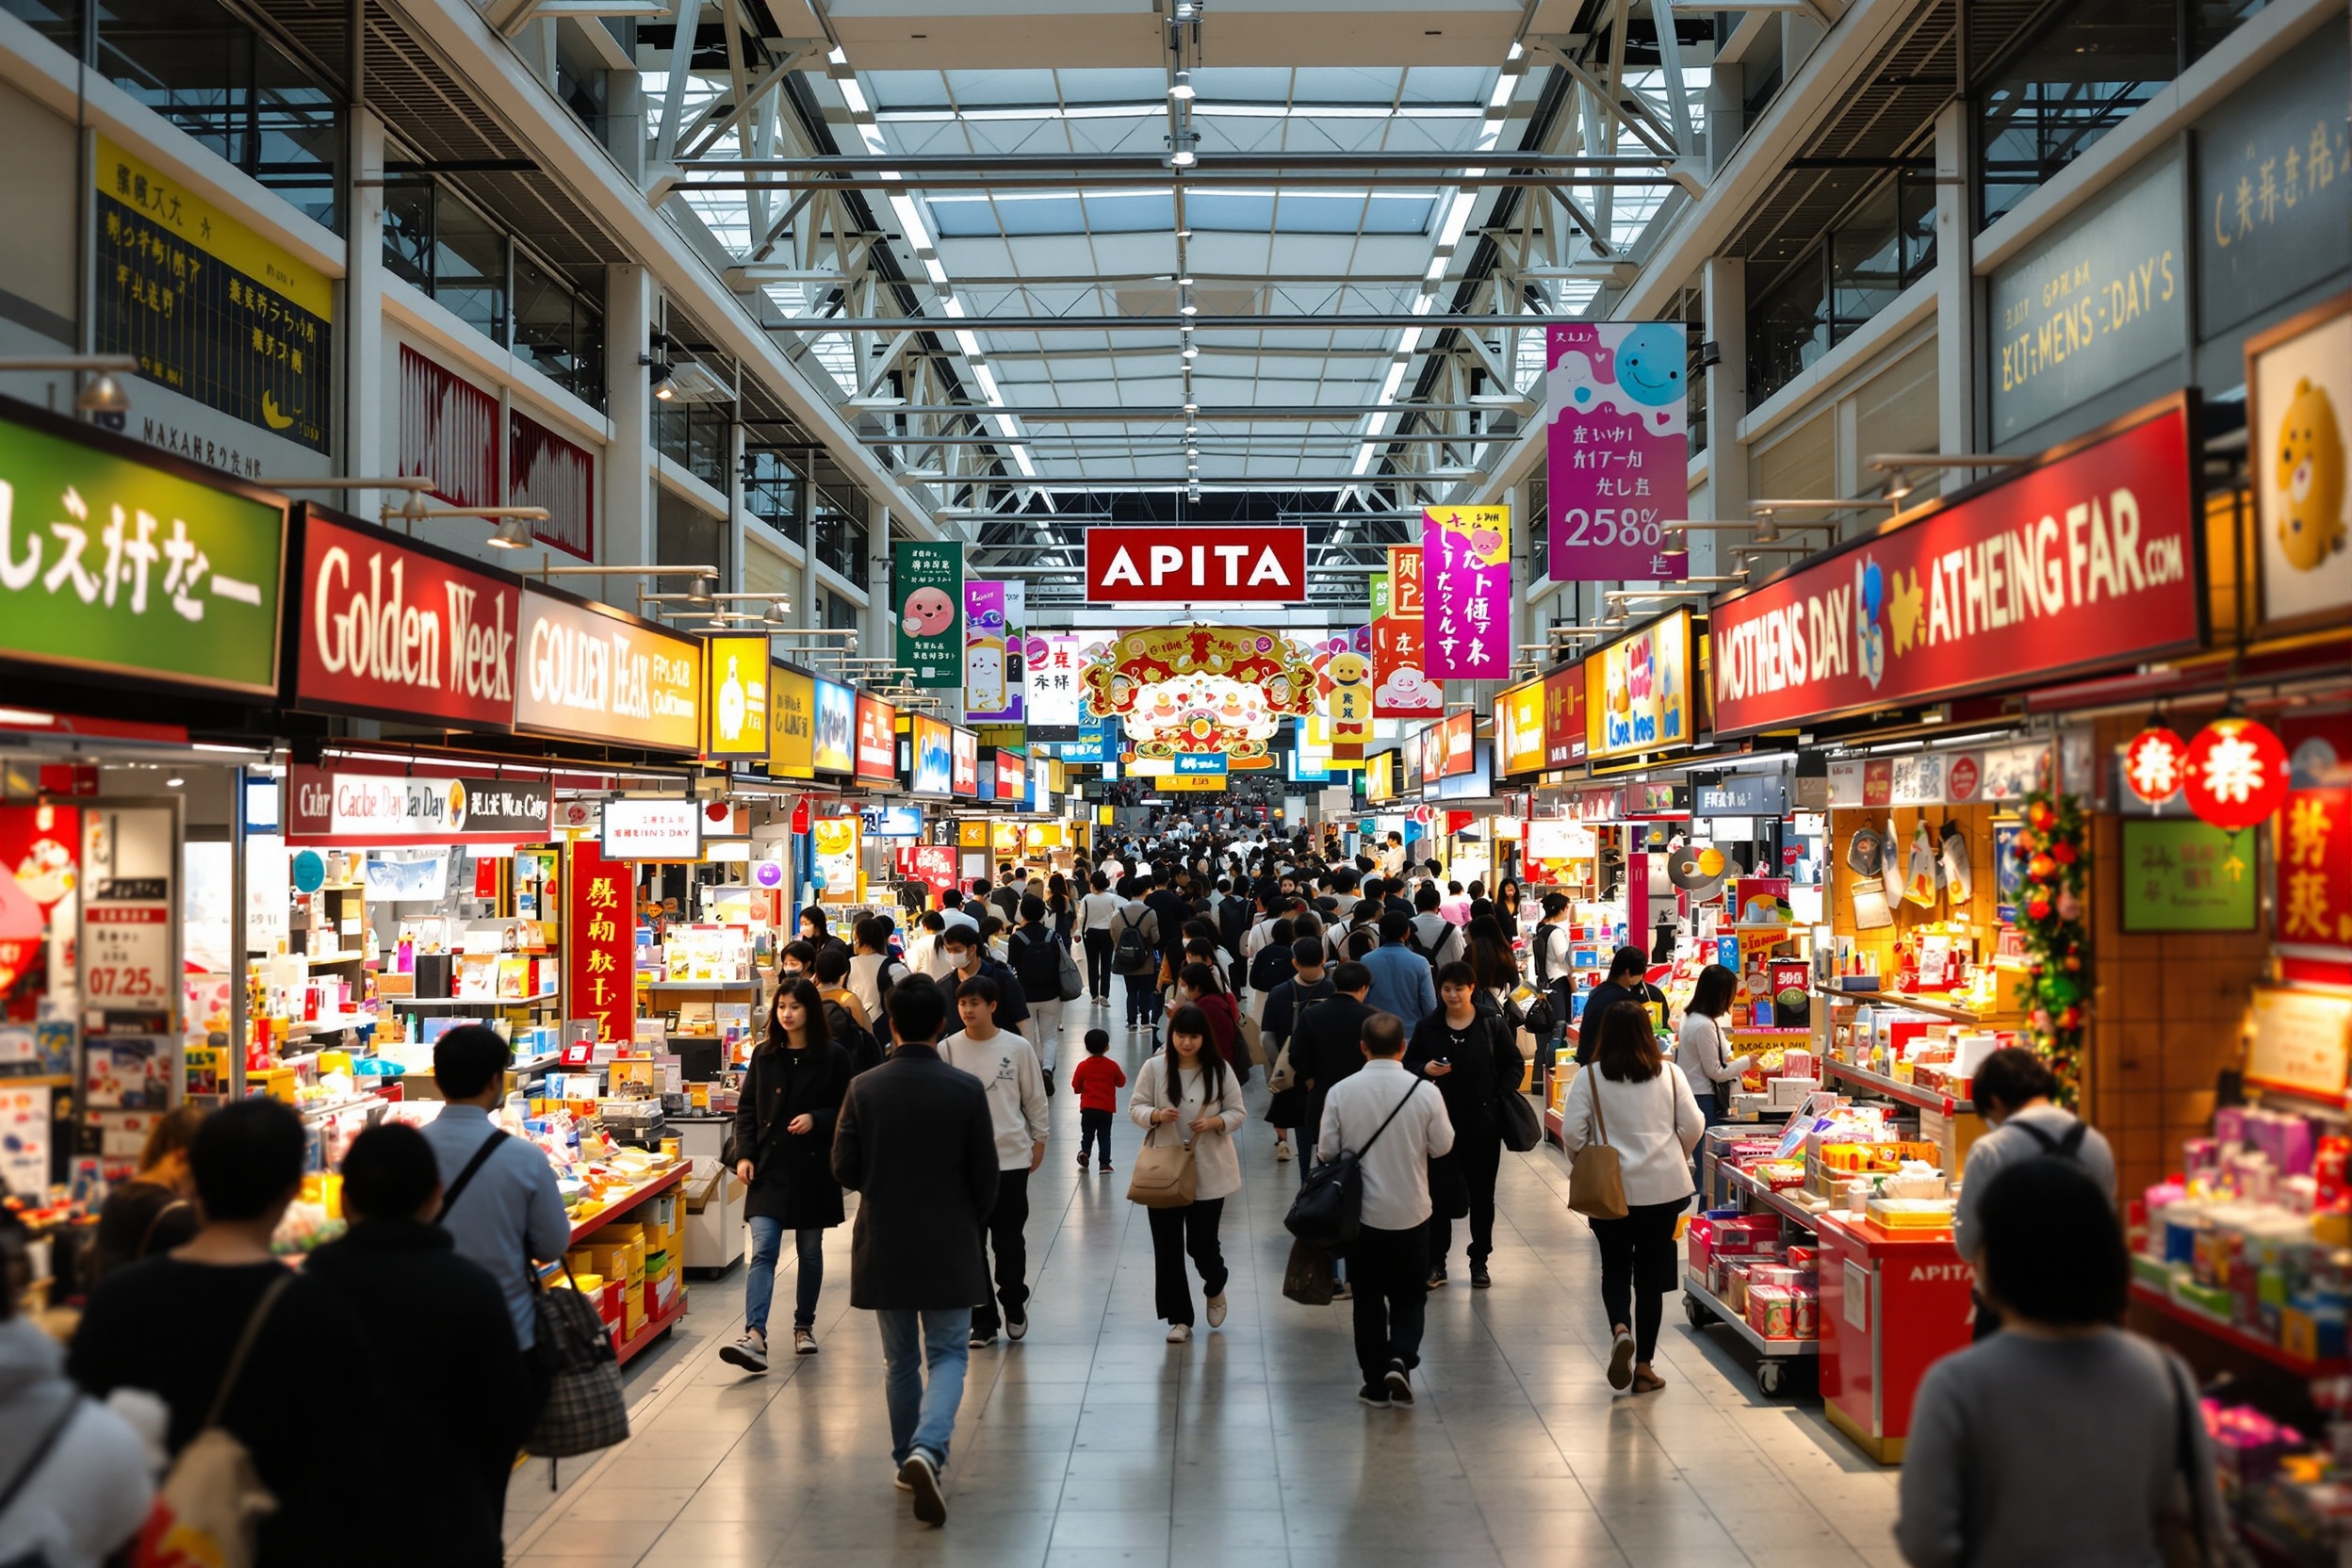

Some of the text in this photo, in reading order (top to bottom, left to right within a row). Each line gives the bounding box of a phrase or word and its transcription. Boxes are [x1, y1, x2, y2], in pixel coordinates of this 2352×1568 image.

[1101, 545, 1292, 586] APITA
[315, 547, 441, 689] Golden
[445, 580, 514, 701] Week
[529, 617, 610, 712] GOLDEN
[1808, 583, 1851, 681] DAY
[422, 786, 446, 824] Day
